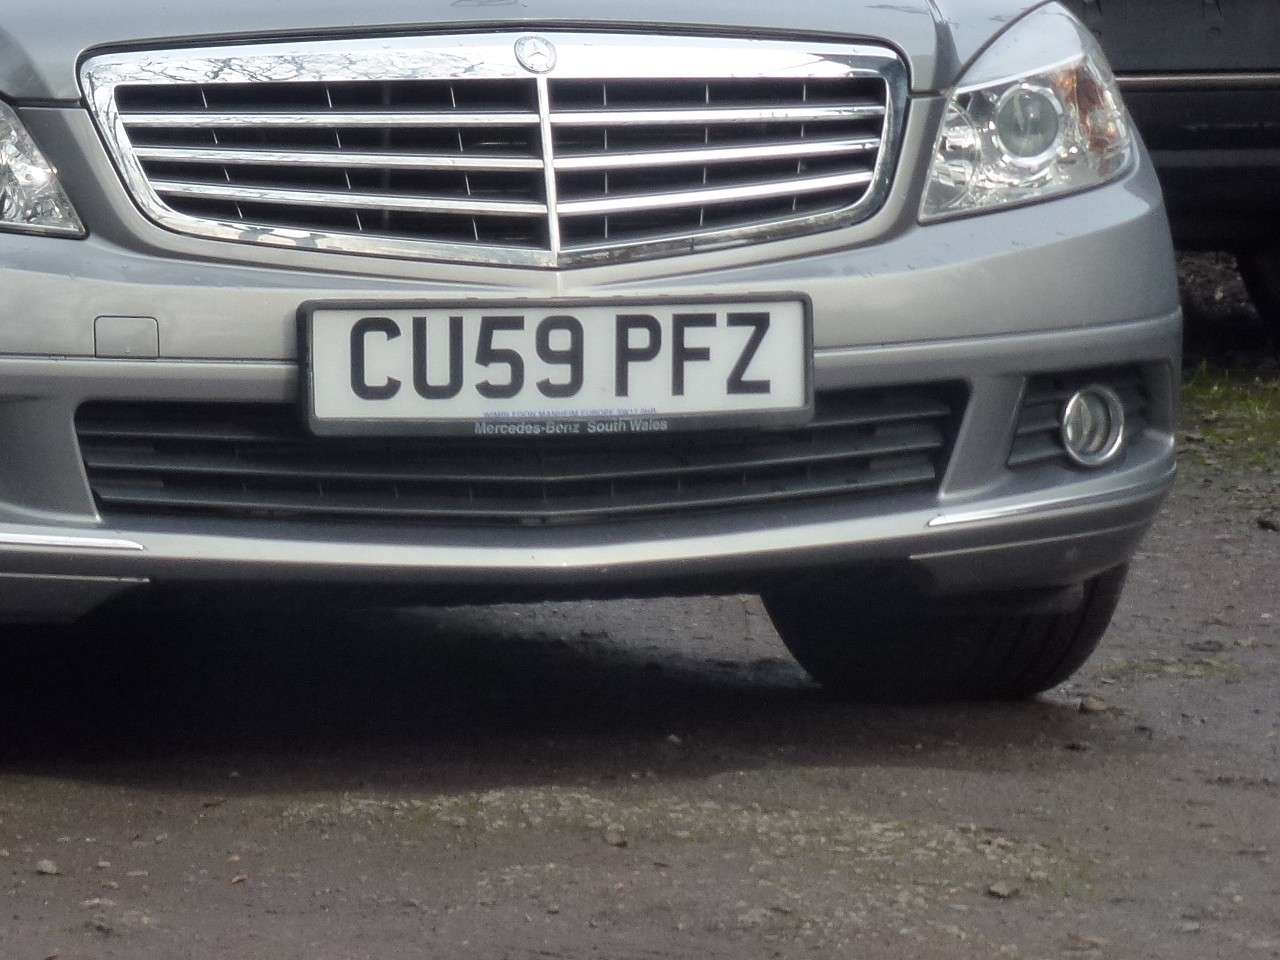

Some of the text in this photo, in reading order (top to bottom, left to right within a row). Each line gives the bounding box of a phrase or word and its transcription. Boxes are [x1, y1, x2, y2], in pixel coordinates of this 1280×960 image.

[350, 311, 771, 401] CU59 PFZ
[474, 418, 668, 435] Mercedes-Benz South Wales
